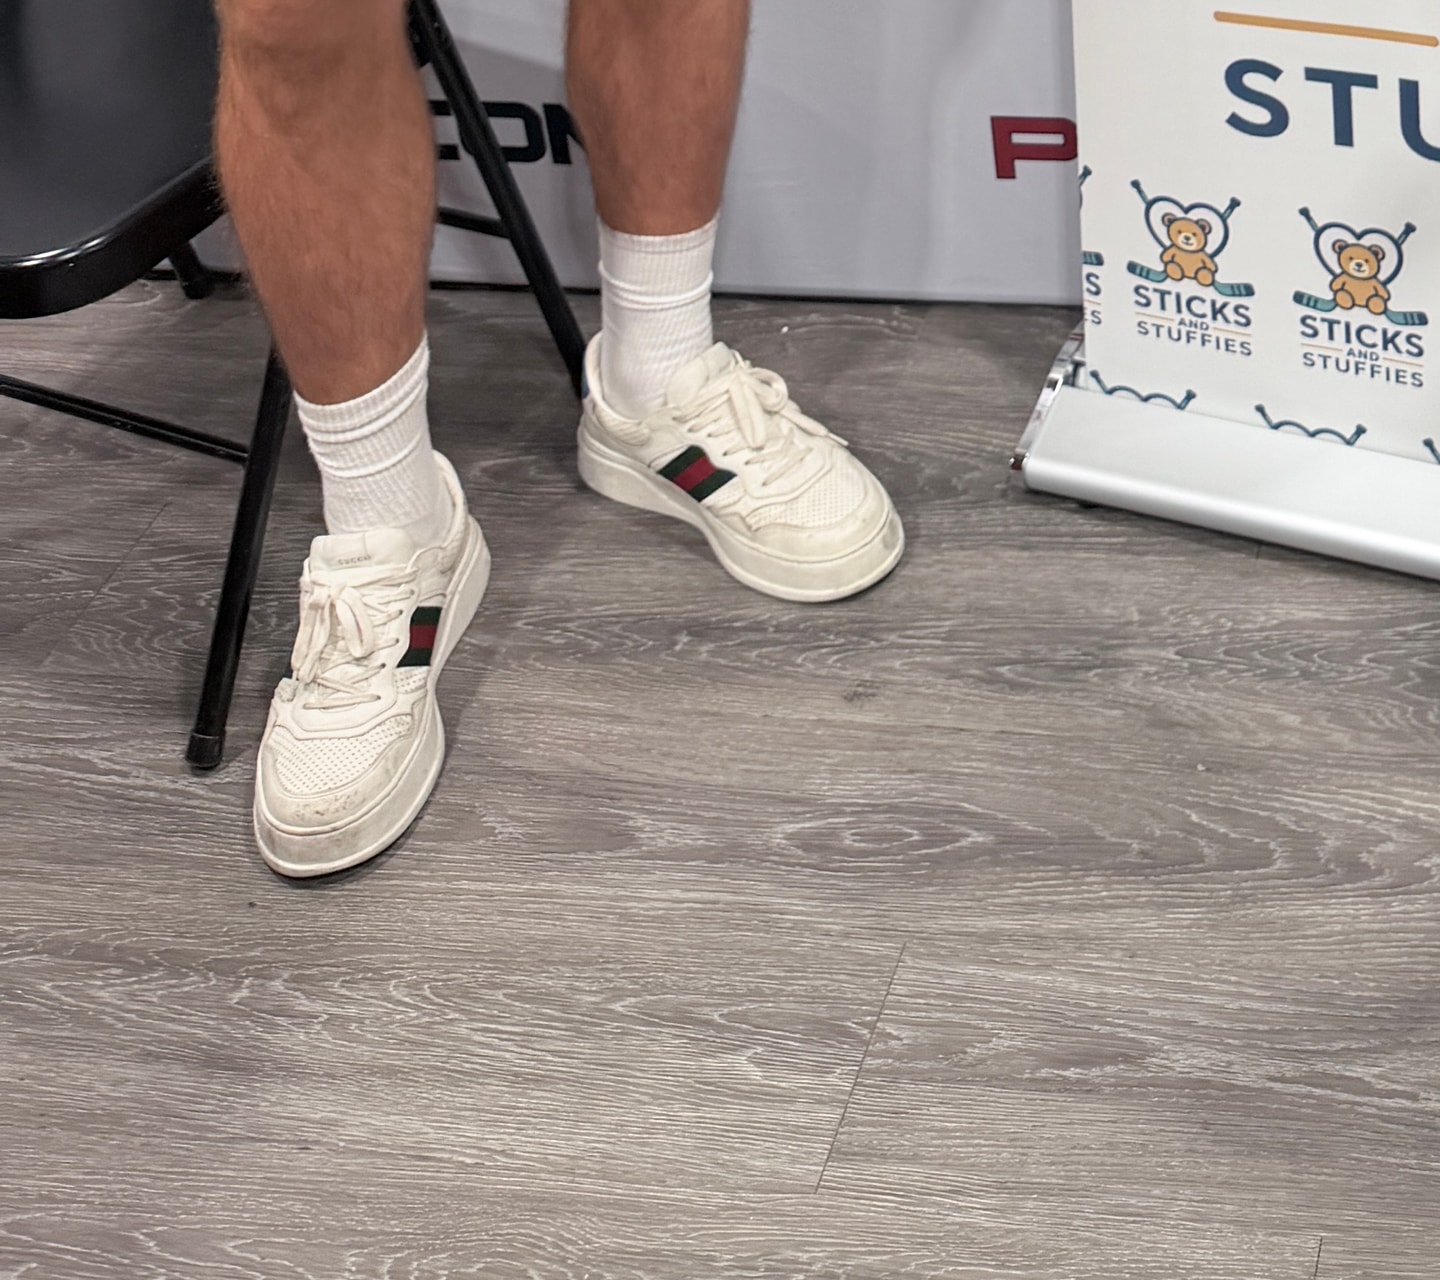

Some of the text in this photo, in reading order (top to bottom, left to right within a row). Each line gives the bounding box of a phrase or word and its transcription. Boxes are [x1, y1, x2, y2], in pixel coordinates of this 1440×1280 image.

[1133, 284, 1252, 328] STICKS
[1178, 317, 1210, 333] AND
[1136, 320, 1252, 357] STUFFIES
[1299, 315, 1425, 359] STICKS
[1346, 346, 1380, 363] AND
[1301, 350, 1425, 389] STUFFIES
